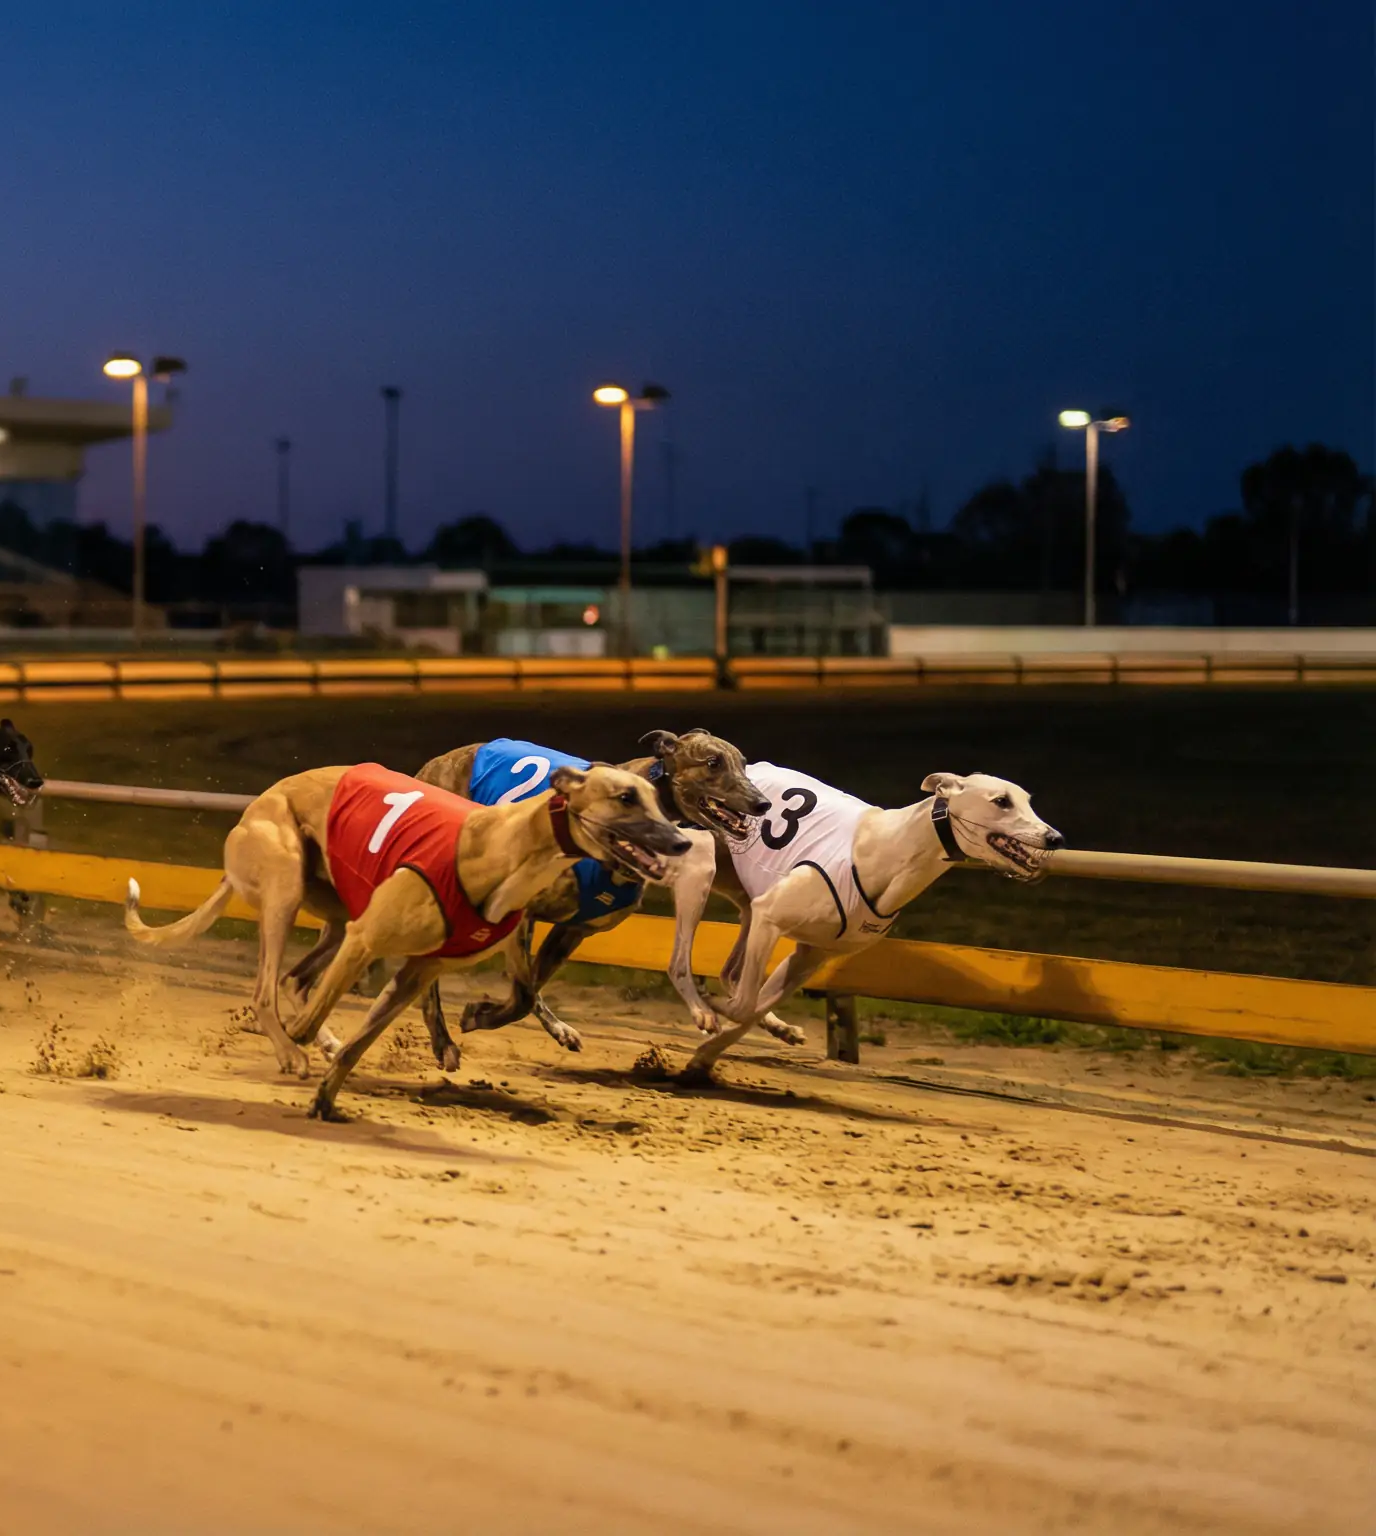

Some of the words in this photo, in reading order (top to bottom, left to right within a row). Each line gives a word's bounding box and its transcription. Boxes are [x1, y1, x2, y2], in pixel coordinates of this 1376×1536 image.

[496, 755, 551, 805] 2
[368, 790, 424, 854] 1
[760, 787, 818, 850] 3
